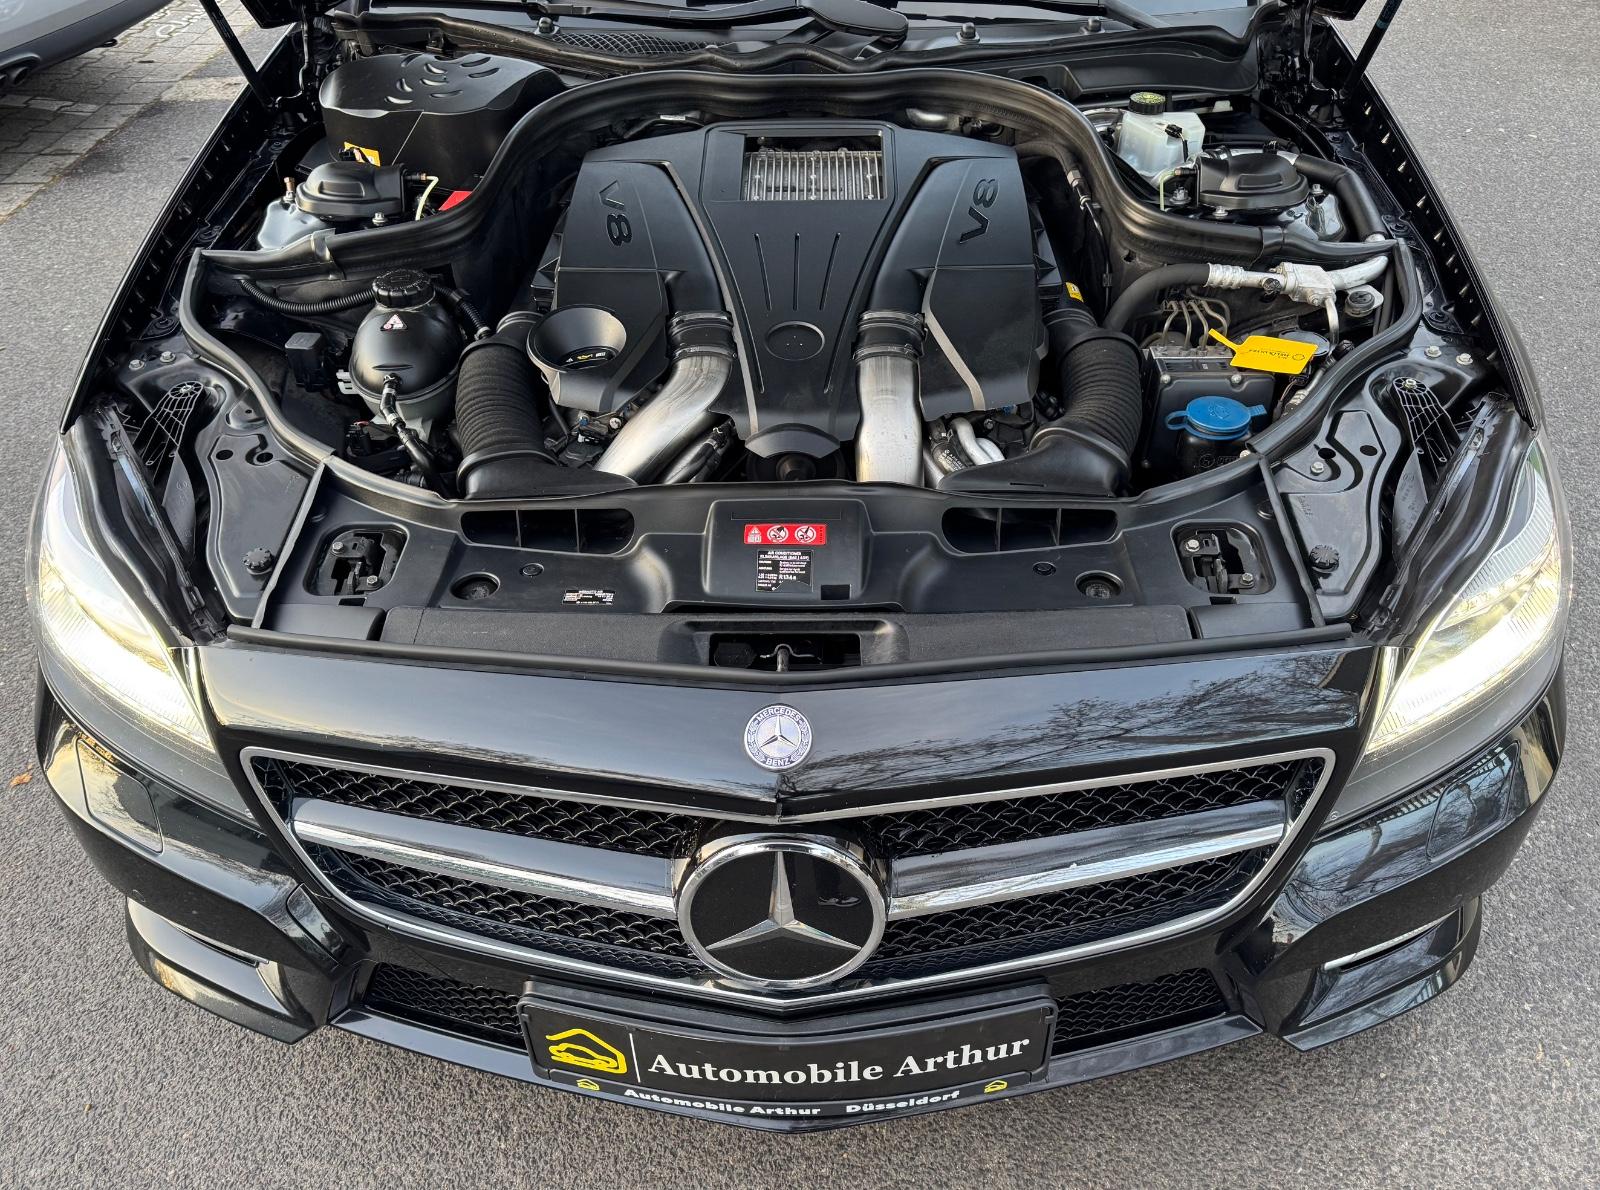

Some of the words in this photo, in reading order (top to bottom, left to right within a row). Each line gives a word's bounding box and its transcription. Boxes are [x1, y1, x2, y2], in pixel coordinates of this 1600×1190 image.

[599, 179, 632, 247] V8
[959, 178, 999, 244] V8
[756, 707, 801, 722] MERCEDES
[765, 757, 791, 767] BENZ
[648, 1054, 884, 1084] Automobile
[893, 1038, 1030, 1077] Arthur
[624, 1088, 745, 1113] Automobile
[749, 1106, 821, 1115] Arthur
[846, 1090, 960, 1113] Düsseldorf
